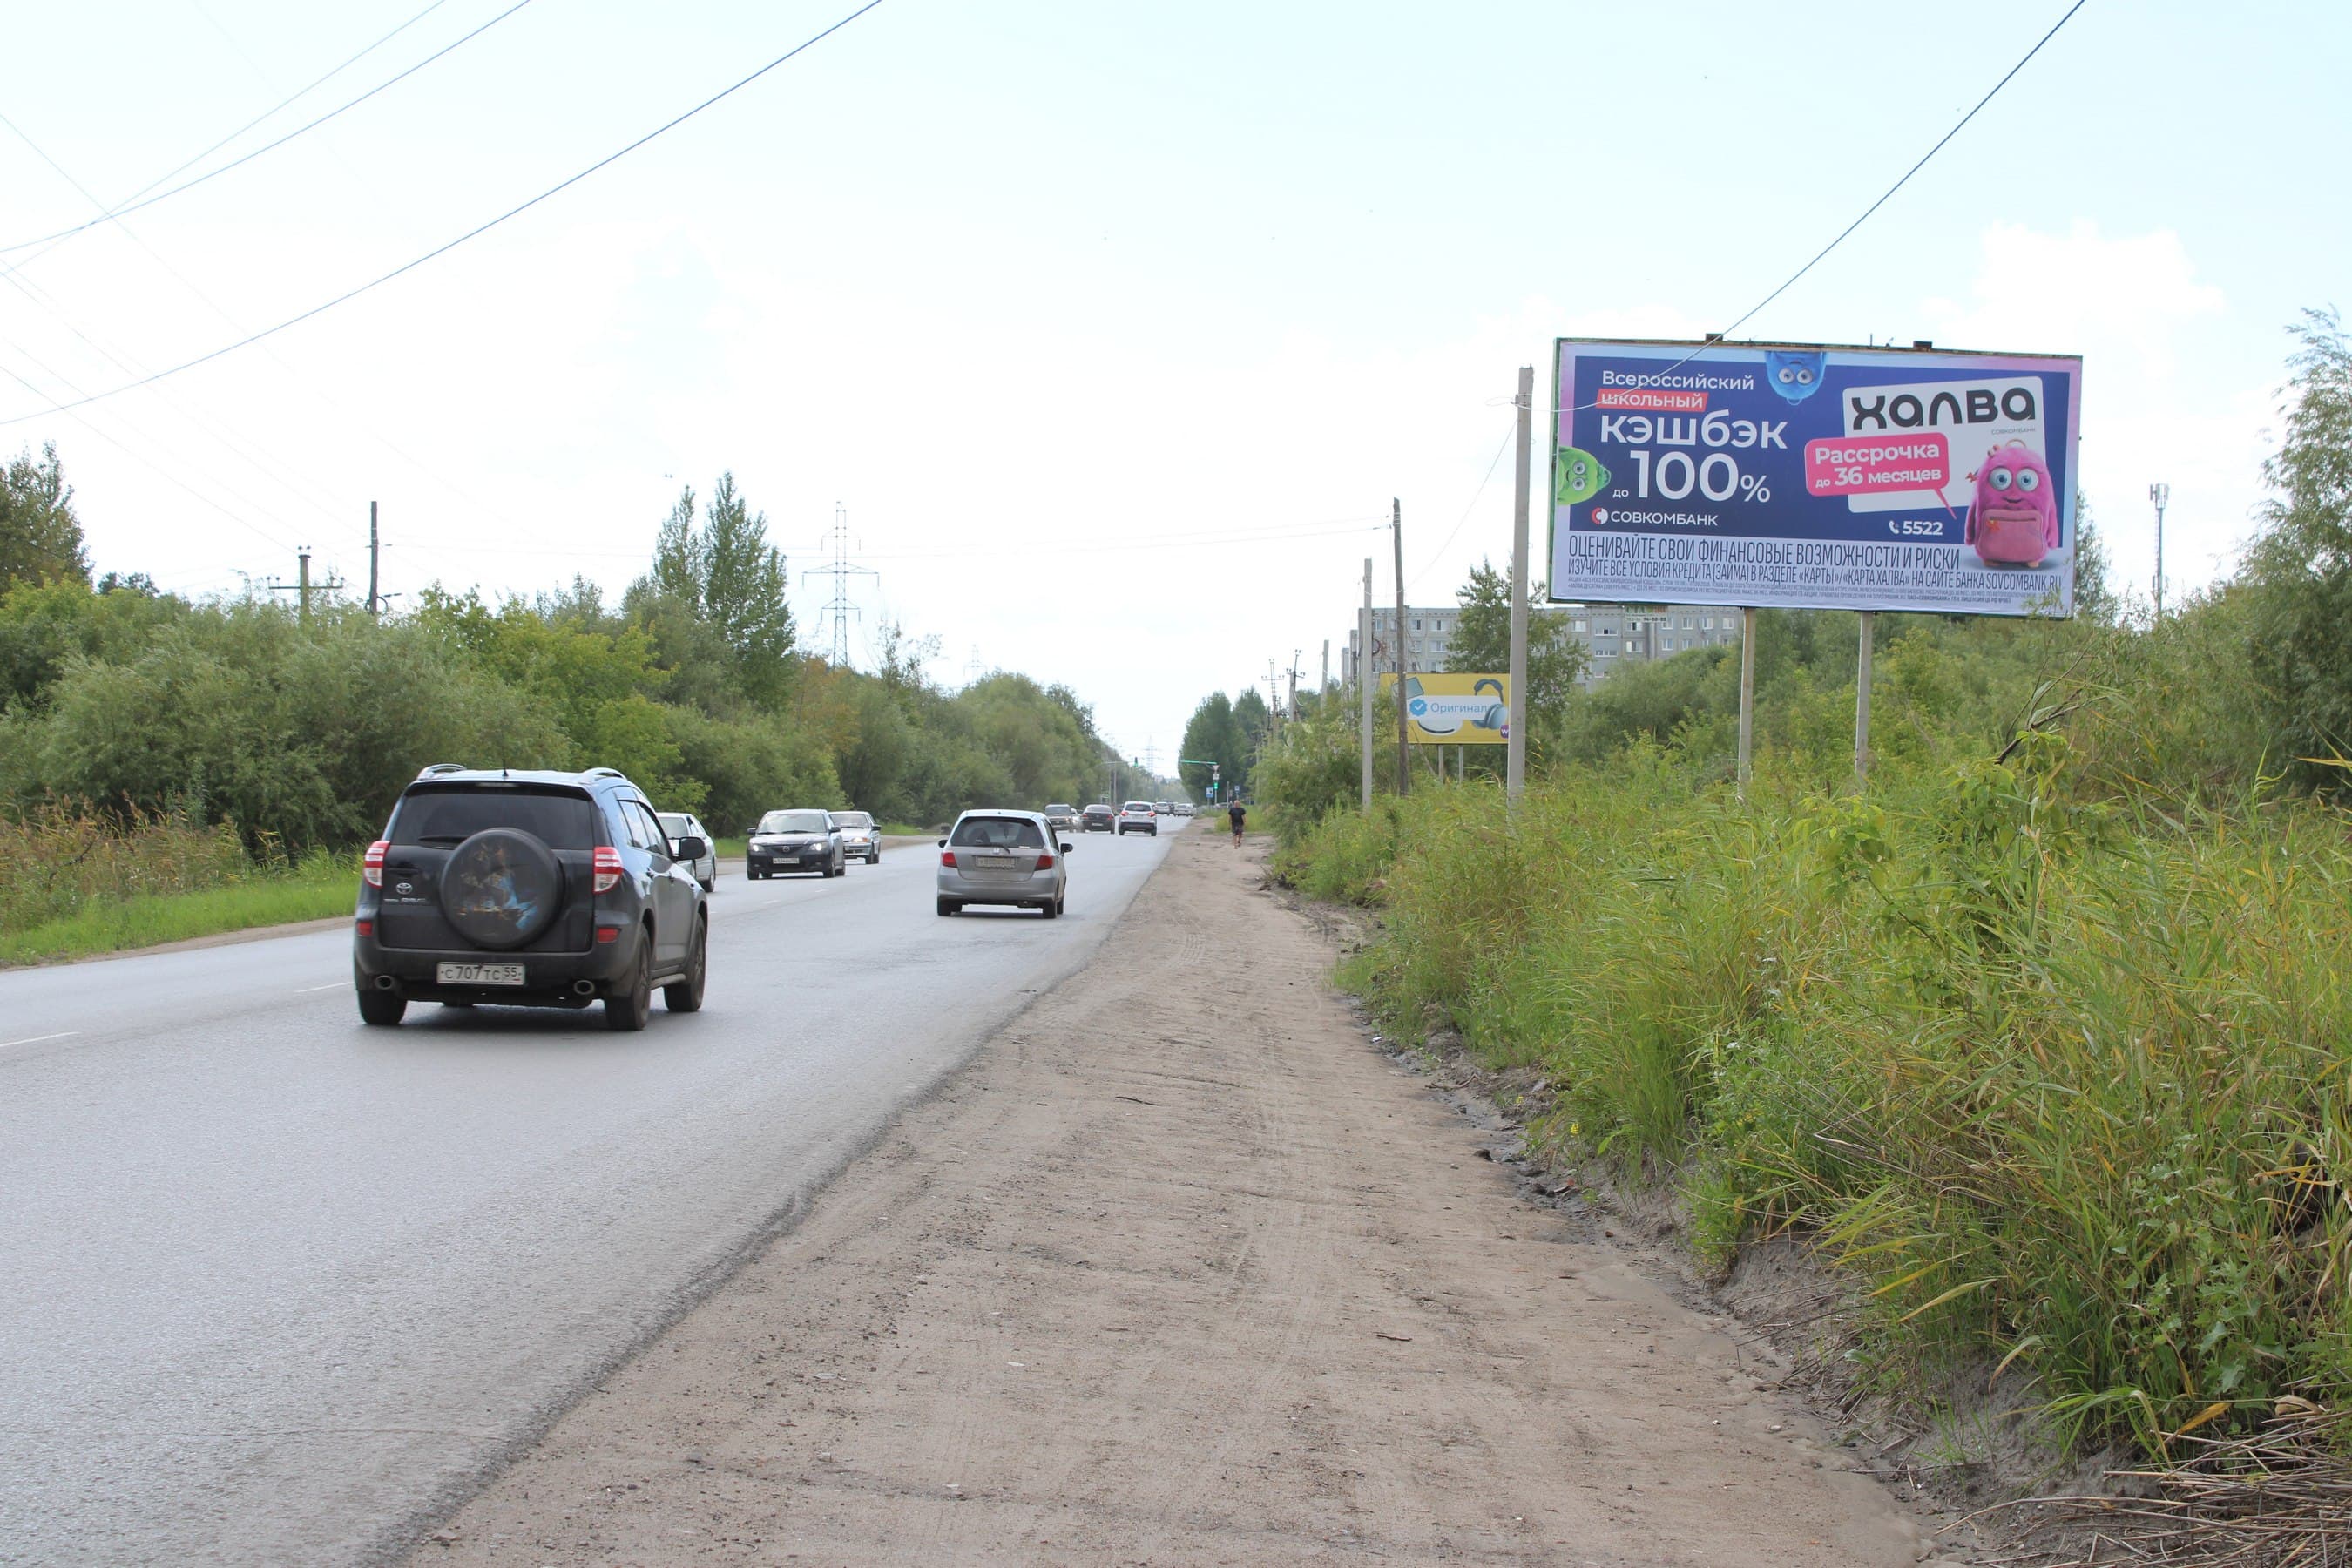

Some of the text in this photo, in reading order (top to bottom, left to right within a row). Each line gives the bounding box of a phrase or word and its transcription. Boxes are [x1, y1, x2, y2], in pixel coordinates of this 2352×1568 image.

[1602, 370, 1754, 390] Всероссийский
[1601, 393, 1703, 409] школьный
[1601, 409, 1788, 449] кэшбэк
[1815, 444, 1939, 465] Рассрочка
[1612, 450, 1771, 503] до 100%
[1815, 466, 1942, 489] до 36 месяцев
[1611, 511, 1719, 526] СОВКОМБАНК
[1902, 521, 1943, 535] 5522
[1569, 533, 1960, 570] ОЦЕНИВАЙТЕ СВОИ ФИНАНСОВЫЕ ВОЗМОЖНОСТИ И РИСКИ
[1568, 558, 1608, 576] ИЗУЧИТЕ
[1612, 560, 1627, 577] ВСЕ
[1629, 560, 1671, 578] УСЛОВИЯ
[1673, 563, 1711, 581] КРЕДИТА
[1713, 564, 1748, 584] (ЗАЙМА)
[1751, 565, 1756, 581] В
[1759, 565, 1797, 585] РАЗДЕЛЕ
[1877, 570, 1909, 586] ХАЛВА»
[1912, 571, 1923, 586] НА
[1926, 570, 1953, 587] САЙТЕ
[1956, 571, 1984, 589] БАНКА
[1986, 573, 2062, 591] SOVCOMBANK.RU
[1430, 703, 1488, 713] Оригинал
